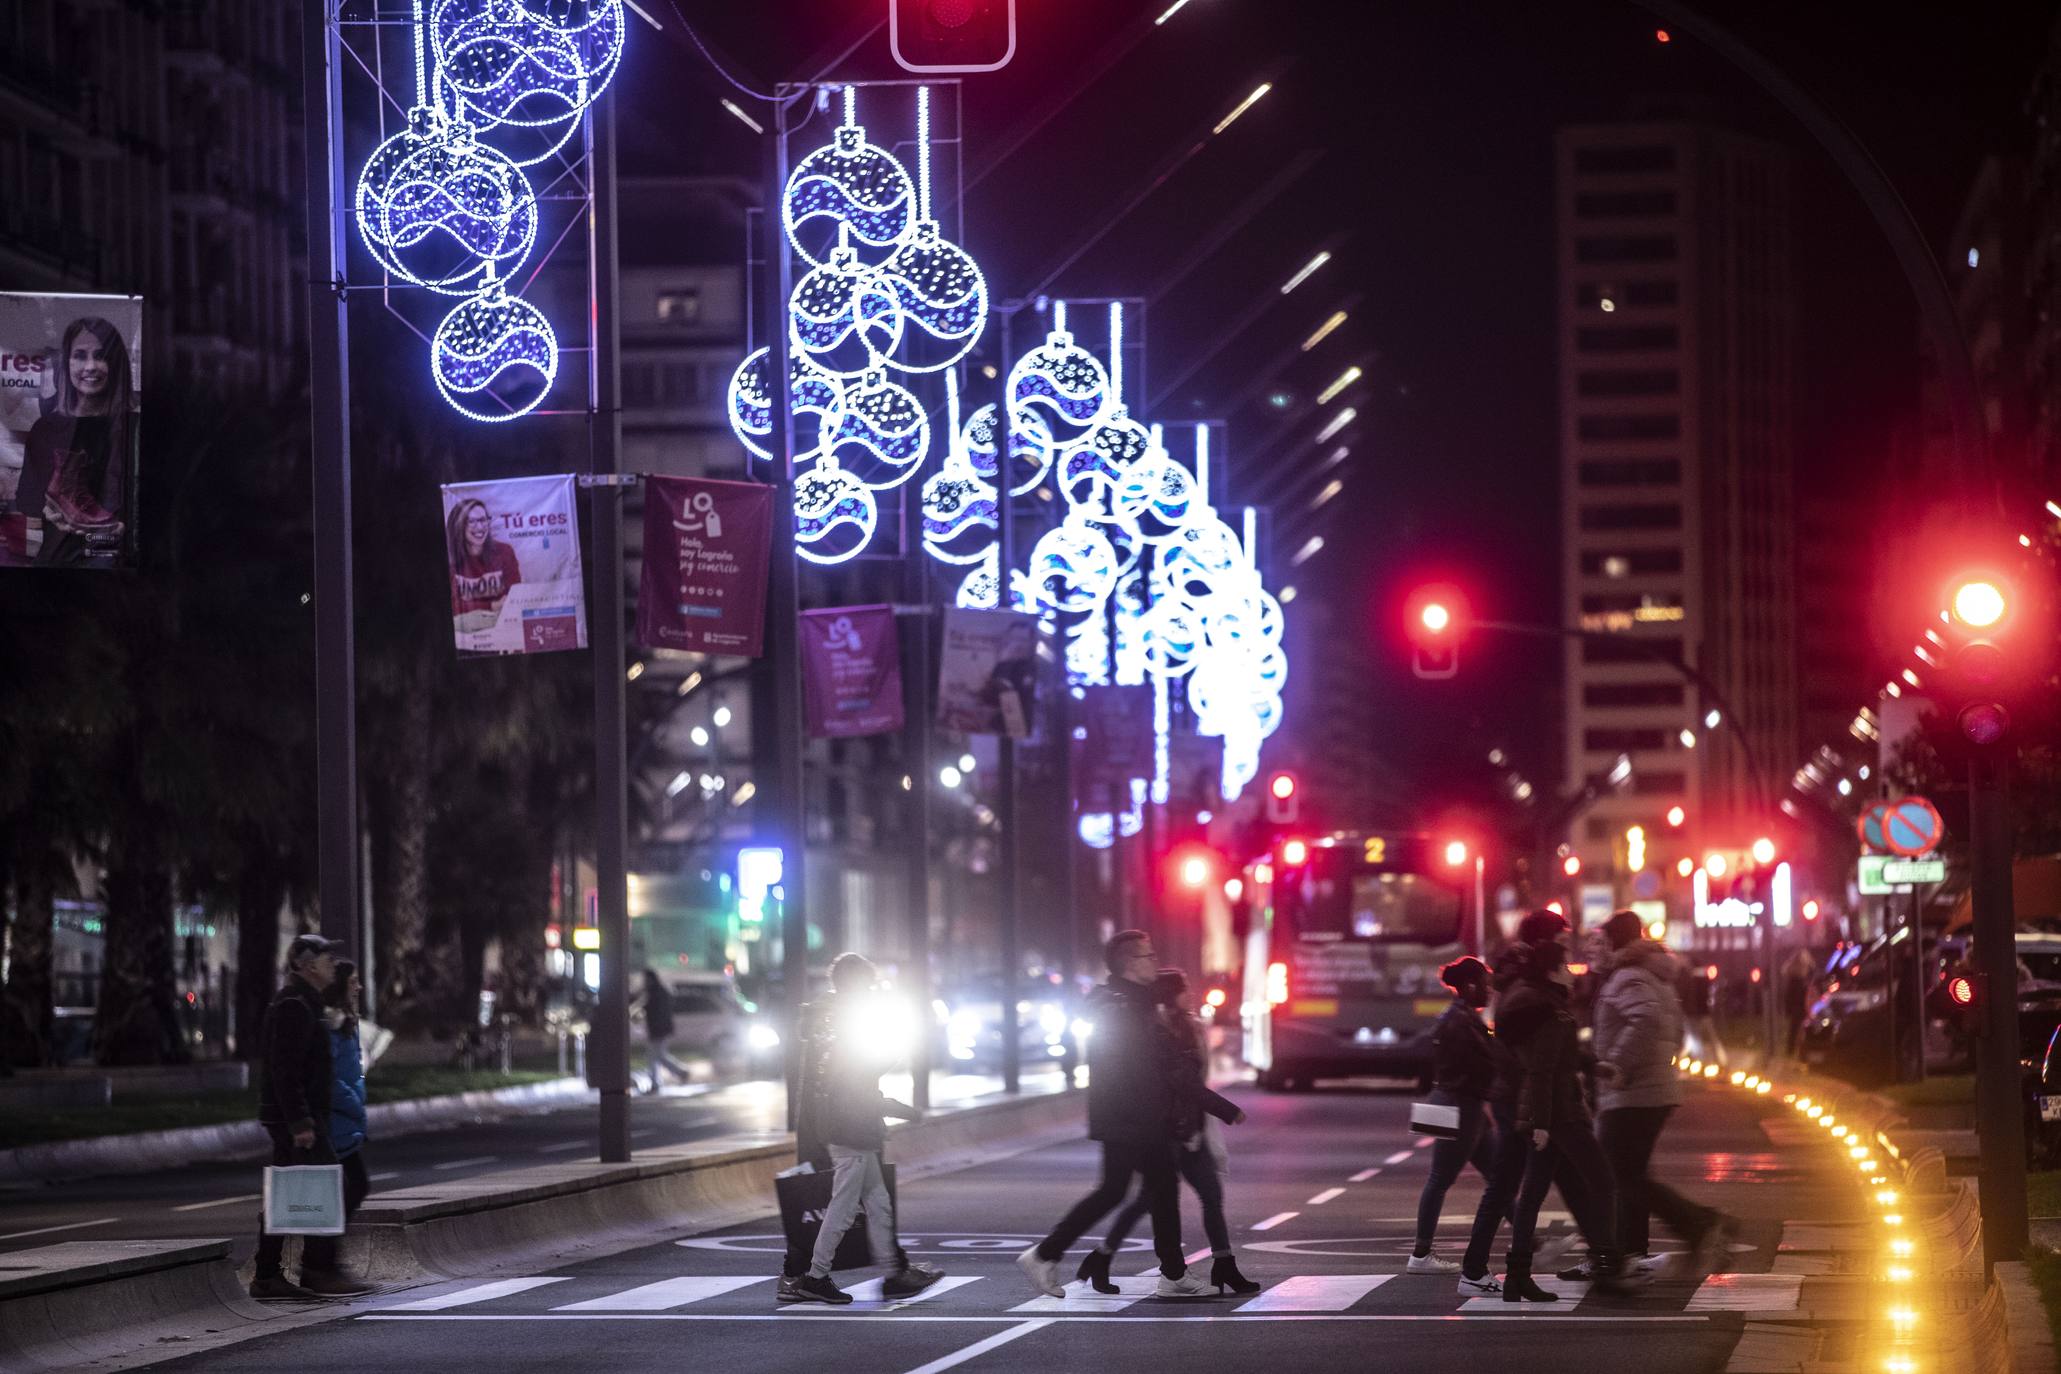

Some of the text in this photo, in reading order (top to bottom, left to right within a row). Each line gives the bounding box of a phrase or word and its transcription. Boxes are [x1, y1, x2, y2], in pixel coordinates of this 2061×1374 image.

[2, 377, 38, 388] LOCAL
[500, 511, 568, 529] Tú eres
[508, 528, 568, 539] COMERCIO LOCAL
[1364, 836, 1386, 863] 2
